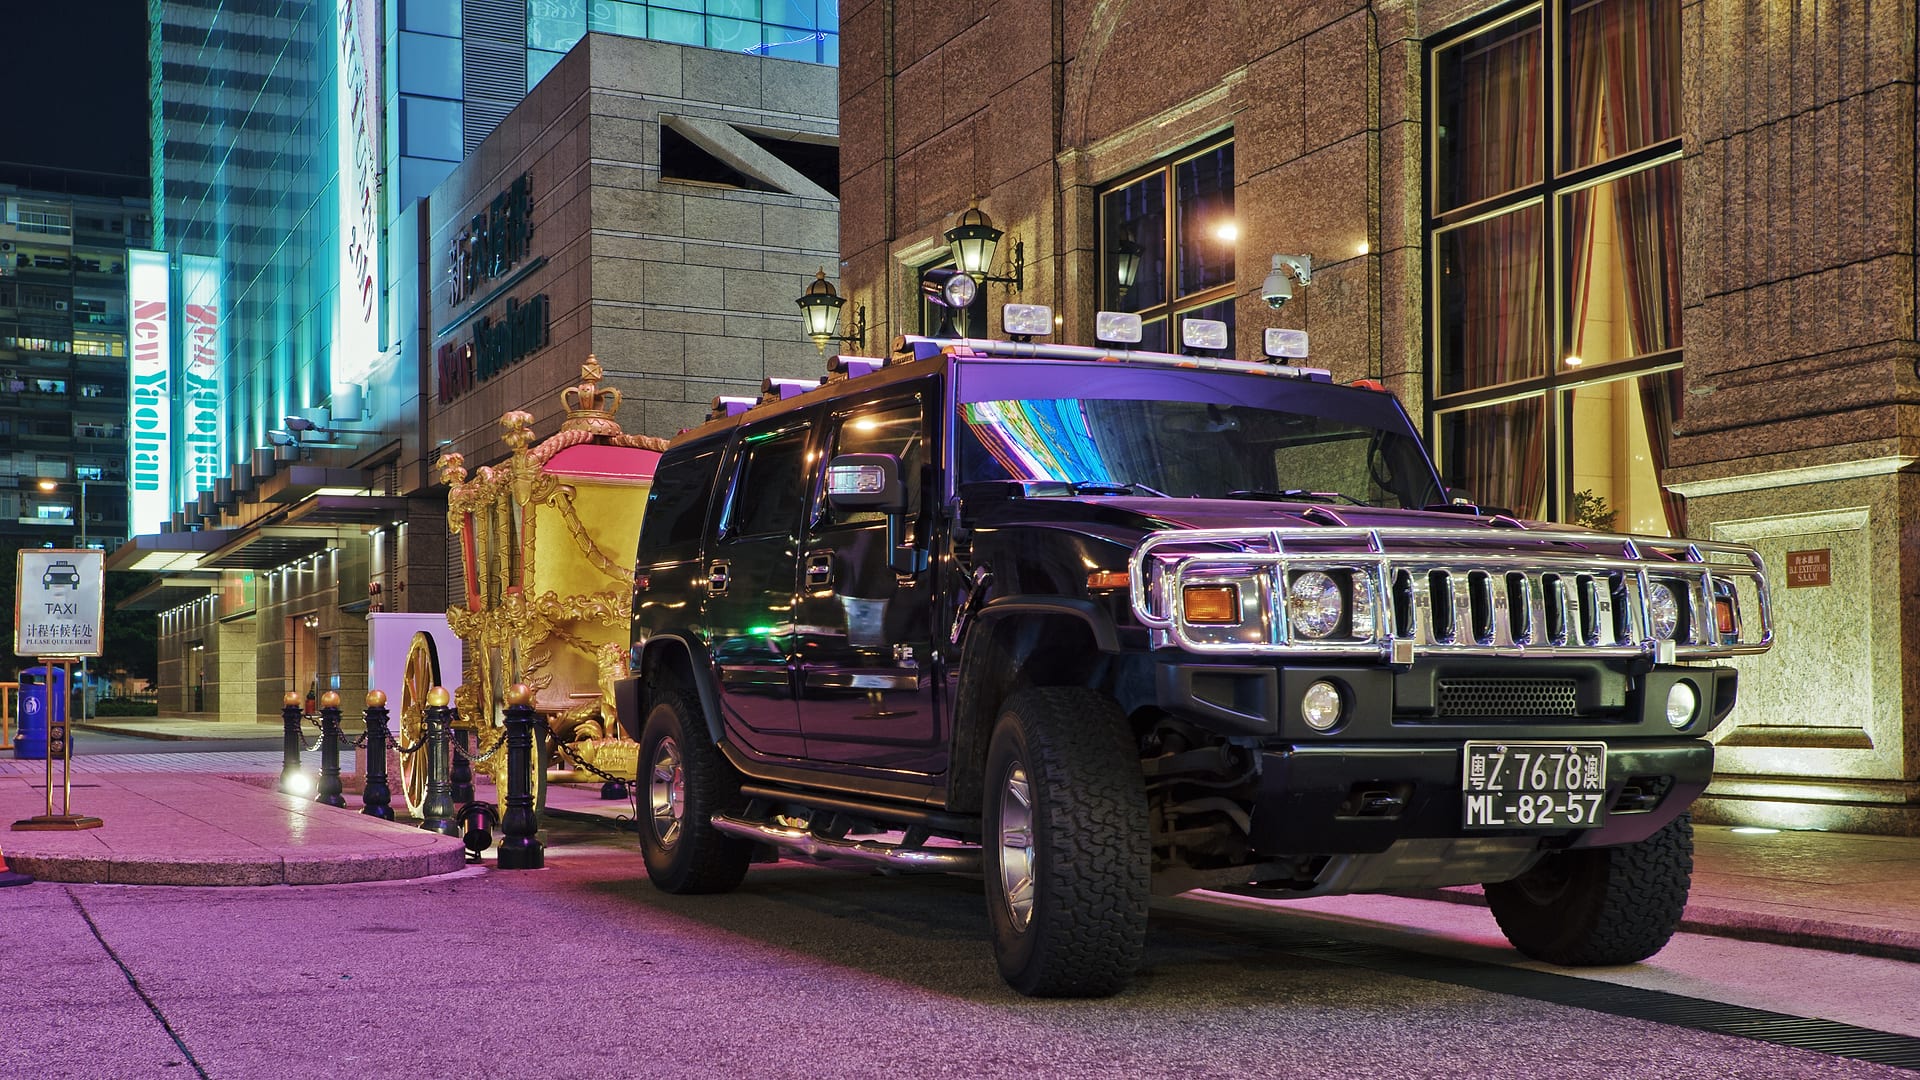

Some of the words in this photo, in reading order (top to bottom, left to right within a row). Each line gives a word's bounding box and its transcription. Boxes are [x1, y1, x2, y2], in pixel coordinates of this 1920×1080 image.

[350, 225, 373, 324] 2010
[134, 300, 167, 365] New
[135, 370, 167, 491] Yaohan
[27, 623, 93, 638] 计程车候车处
[44, 603, 77, 615] TAXI
[1467, 795, 1602, 825] ML-82-57
